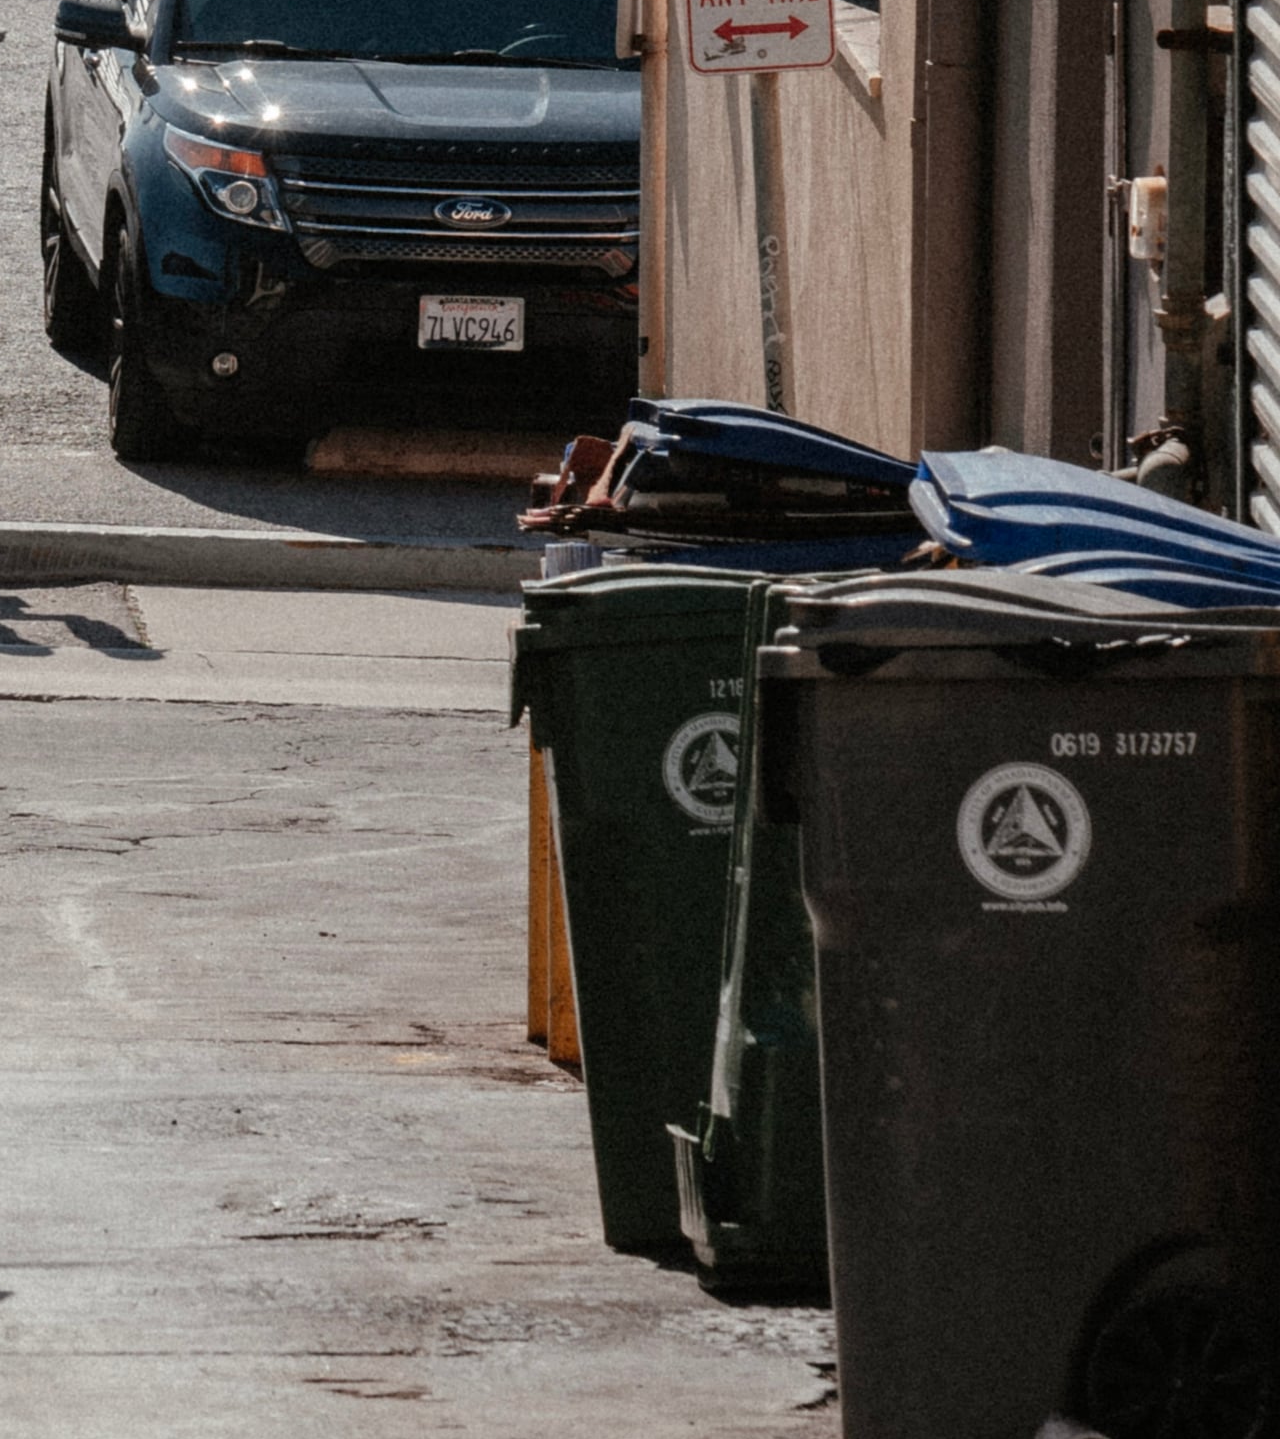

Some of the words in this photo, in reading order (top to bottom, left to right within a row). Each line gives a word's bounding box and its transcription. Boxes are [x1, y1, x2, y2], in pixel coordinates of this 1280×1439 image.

[451, 201, 494, 220] Ford
[427, 316, 516, 342] 7LVC946
[1050, 732, 1101, 757] 0619
[1115, 732, 1198, 756] 3173757
